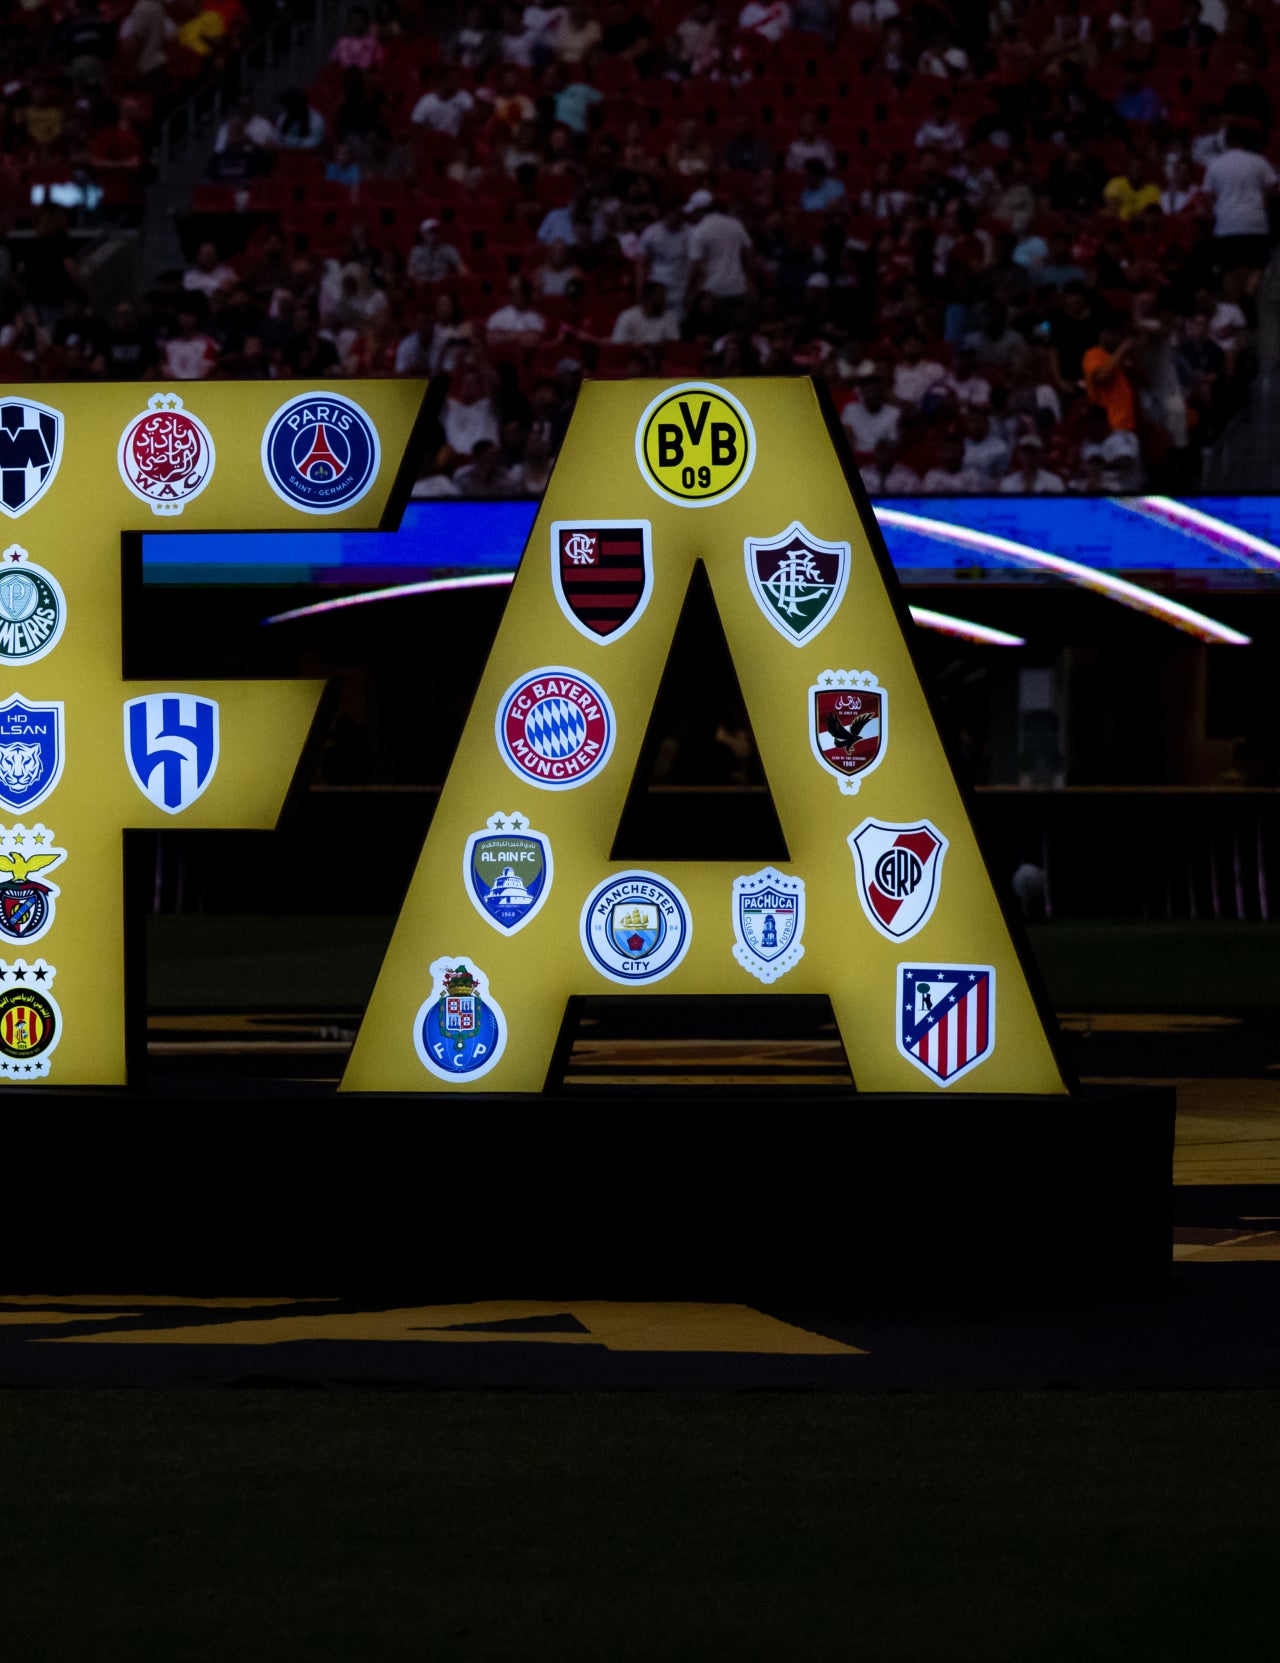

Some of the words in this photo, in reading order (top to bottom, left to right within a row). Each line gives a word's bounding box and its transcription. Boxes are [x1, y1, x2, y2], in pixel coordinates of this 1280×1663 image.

[286, 406, 353, 431] PARIS
[658, 401, 738, 467] BVB
[289, 476, 312, 495] SAINT
[318, 476, 354, 496] GERMAIN
[682, 466, 711, 490] 09
[511, 695, 532, 720] FC
[531, 680, 601, 721] BAYERN
[7, 714, 28, 723] HD
[511, 738, 600, 777] MÜNCHEN
[481, 852, 496, 862] AL
[498, 852, 518, 862] AIN
[520, 852, 536, 862] FC
[597, 884, 675, 916] MANCHESTER
[744, 894, 793, 909] PACHUCA
[745, 916, 754, 936] CLUB
[622, 962, 650, 971] CITY
